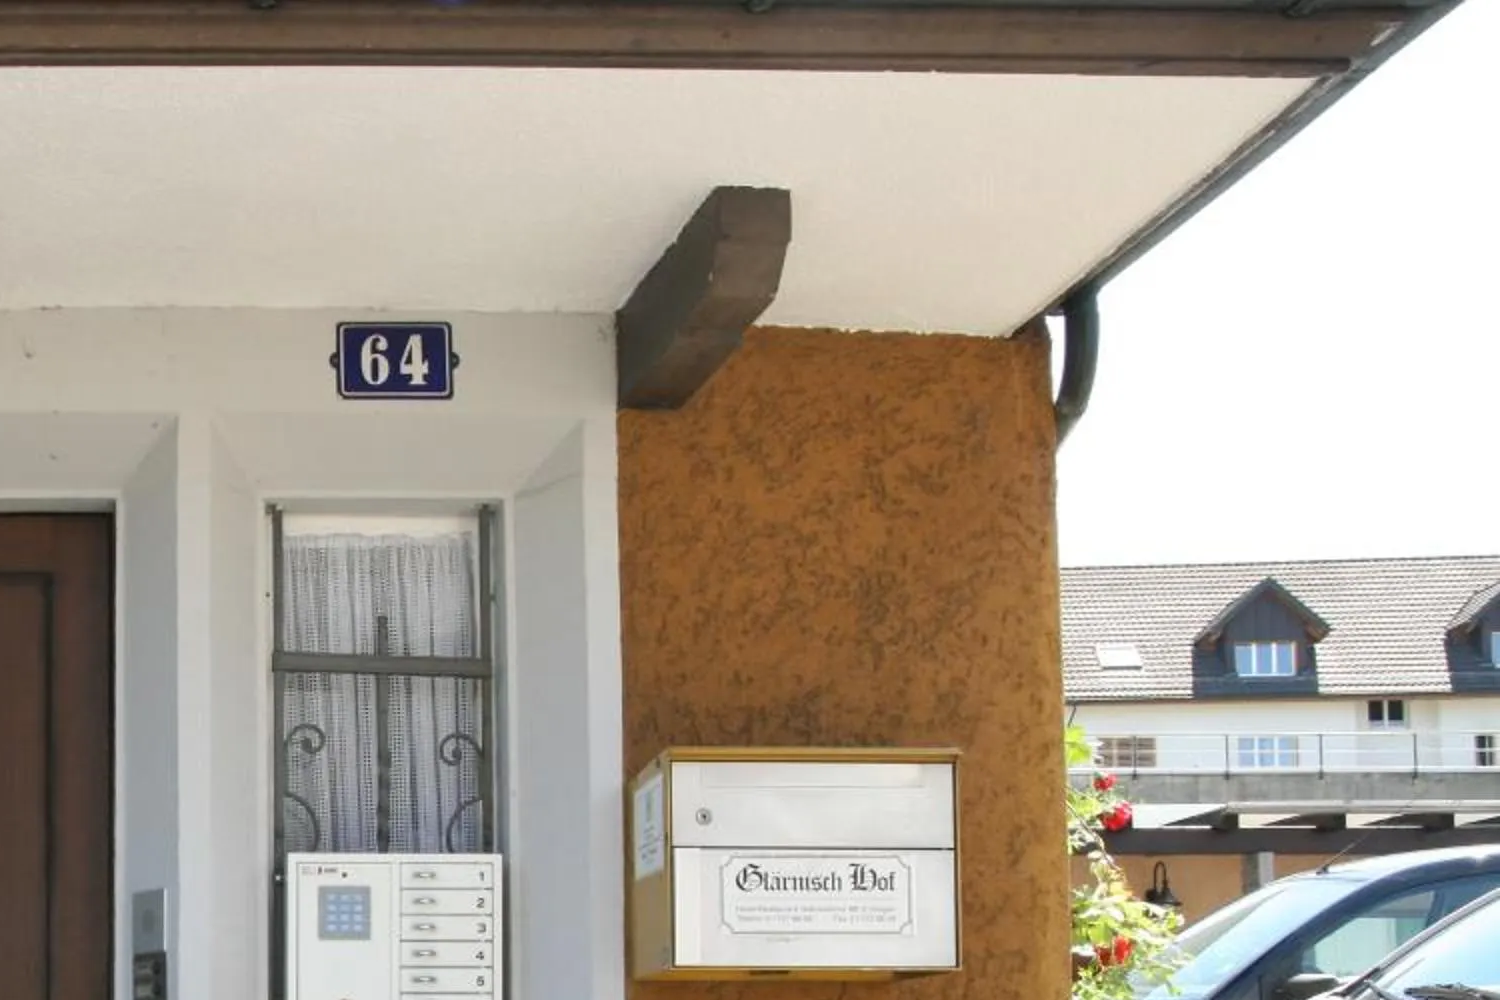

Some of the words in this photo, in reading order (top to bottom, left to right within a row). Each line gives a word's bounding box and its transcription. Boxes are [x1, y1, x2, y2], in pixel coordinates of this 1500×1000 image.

[361, 333, 429, 385] 64
[479, 871, 485, 881] 1
[735, 863, 842, 892] Glärnisch
[849, 863, 897, 892] Hof
[475, 897, 485, 908] 2
[475, 950, 485, 960] 4
[475, 976, 485, 986] 5
